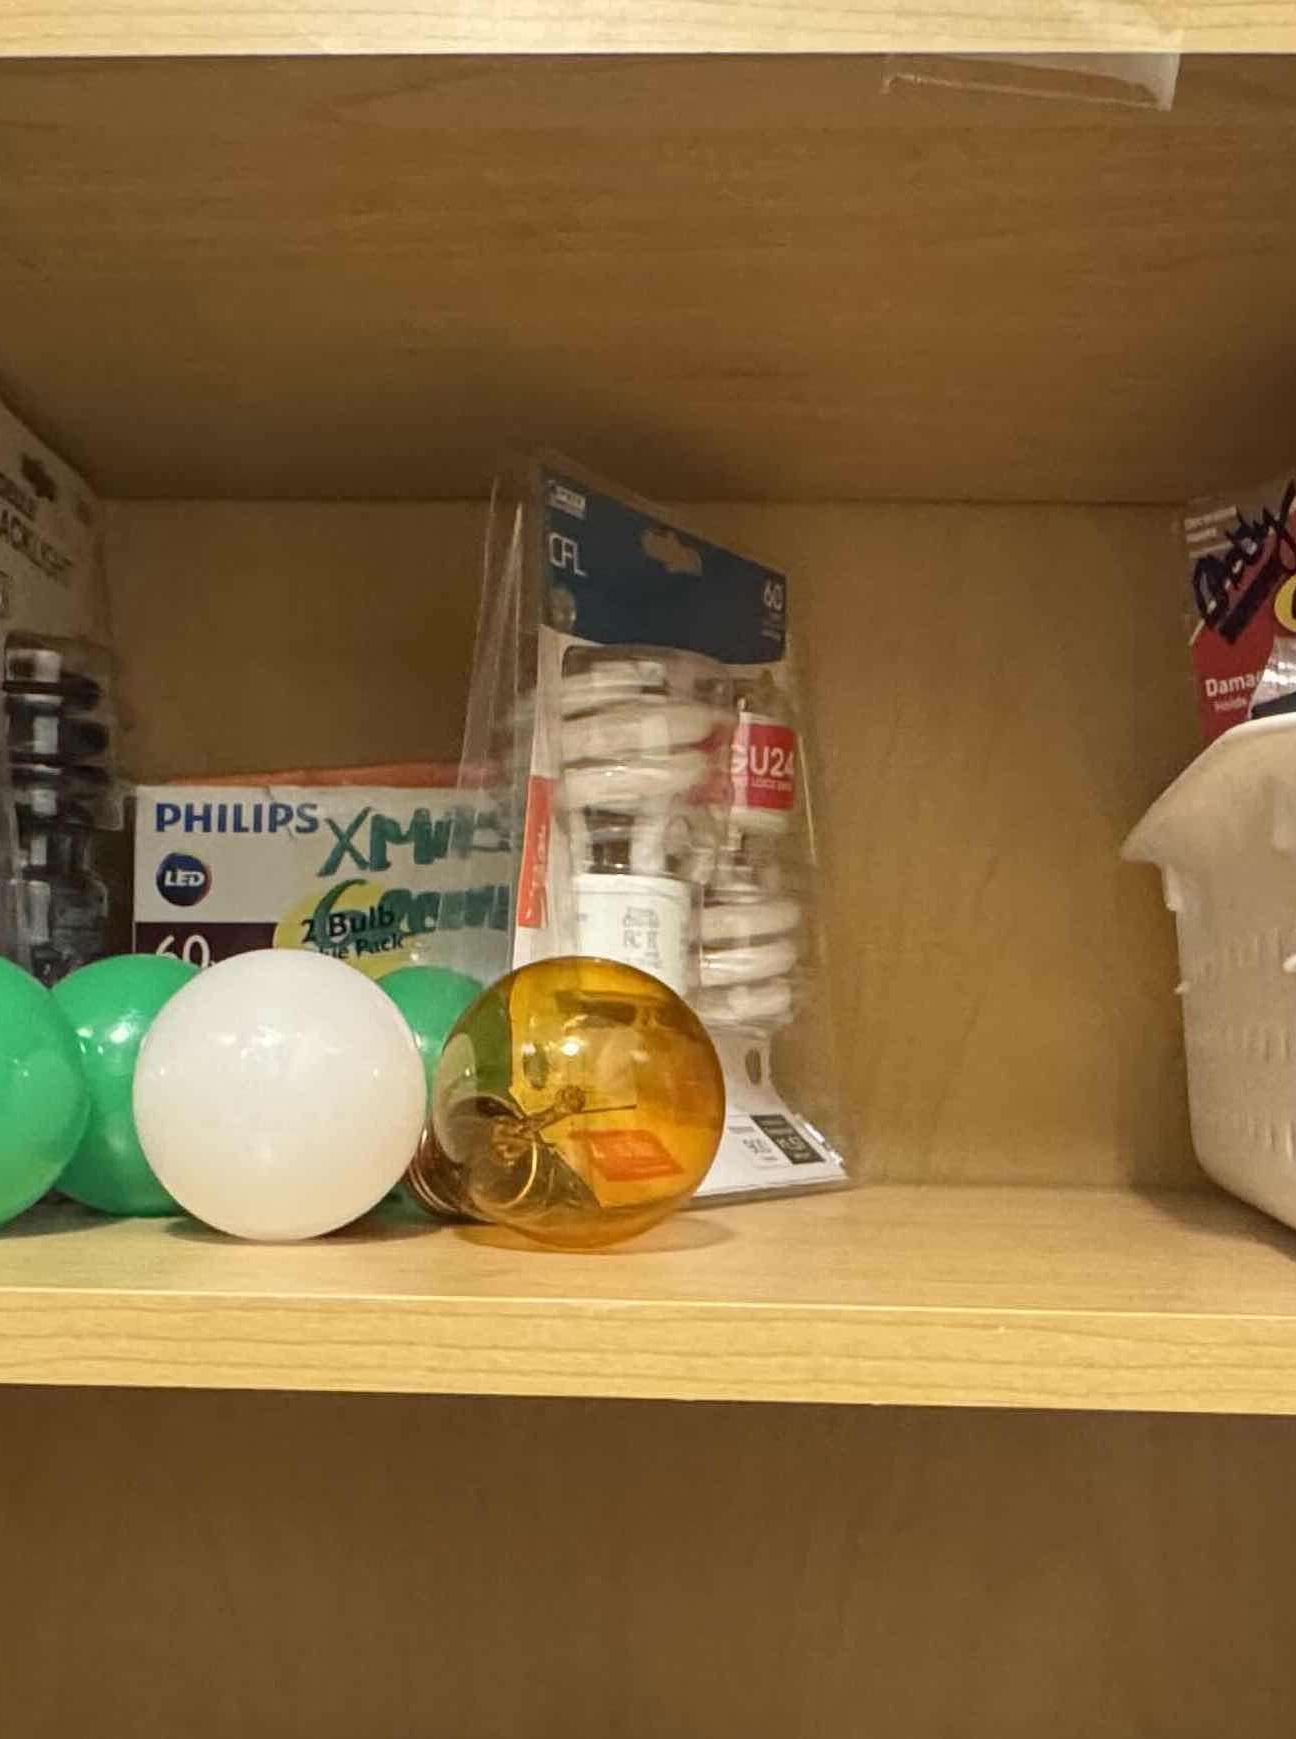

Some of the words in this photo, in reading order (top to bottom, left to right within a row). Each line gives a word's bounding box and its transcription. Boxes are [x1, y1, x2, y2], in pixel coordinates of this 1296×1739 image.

[549, 532, 587, 577] CFL
[155, 802, 320, 834] PHILIPS
[163, 868, 205, 887] LED
[329, 904, 396, 938] Bulb
